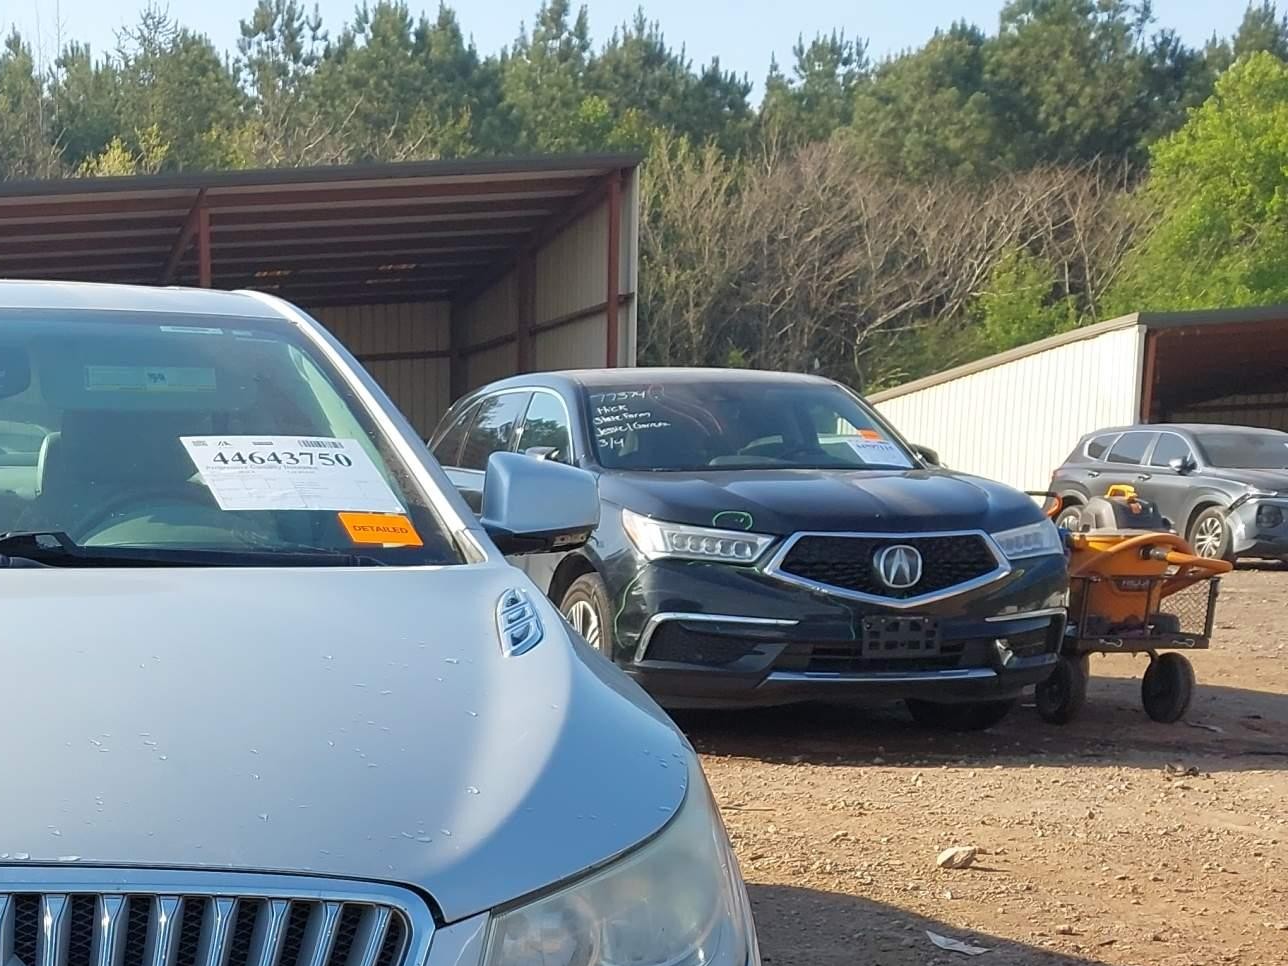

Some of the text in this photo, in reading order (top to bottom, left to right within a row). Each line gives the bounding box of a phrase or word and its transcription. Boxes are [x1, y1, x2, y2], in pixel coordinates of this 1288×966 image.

[598, 437, 625, 449] 3/4
[213, 451, 353, 467] 44643750
[352, 525, 409, 534] DETAILED
